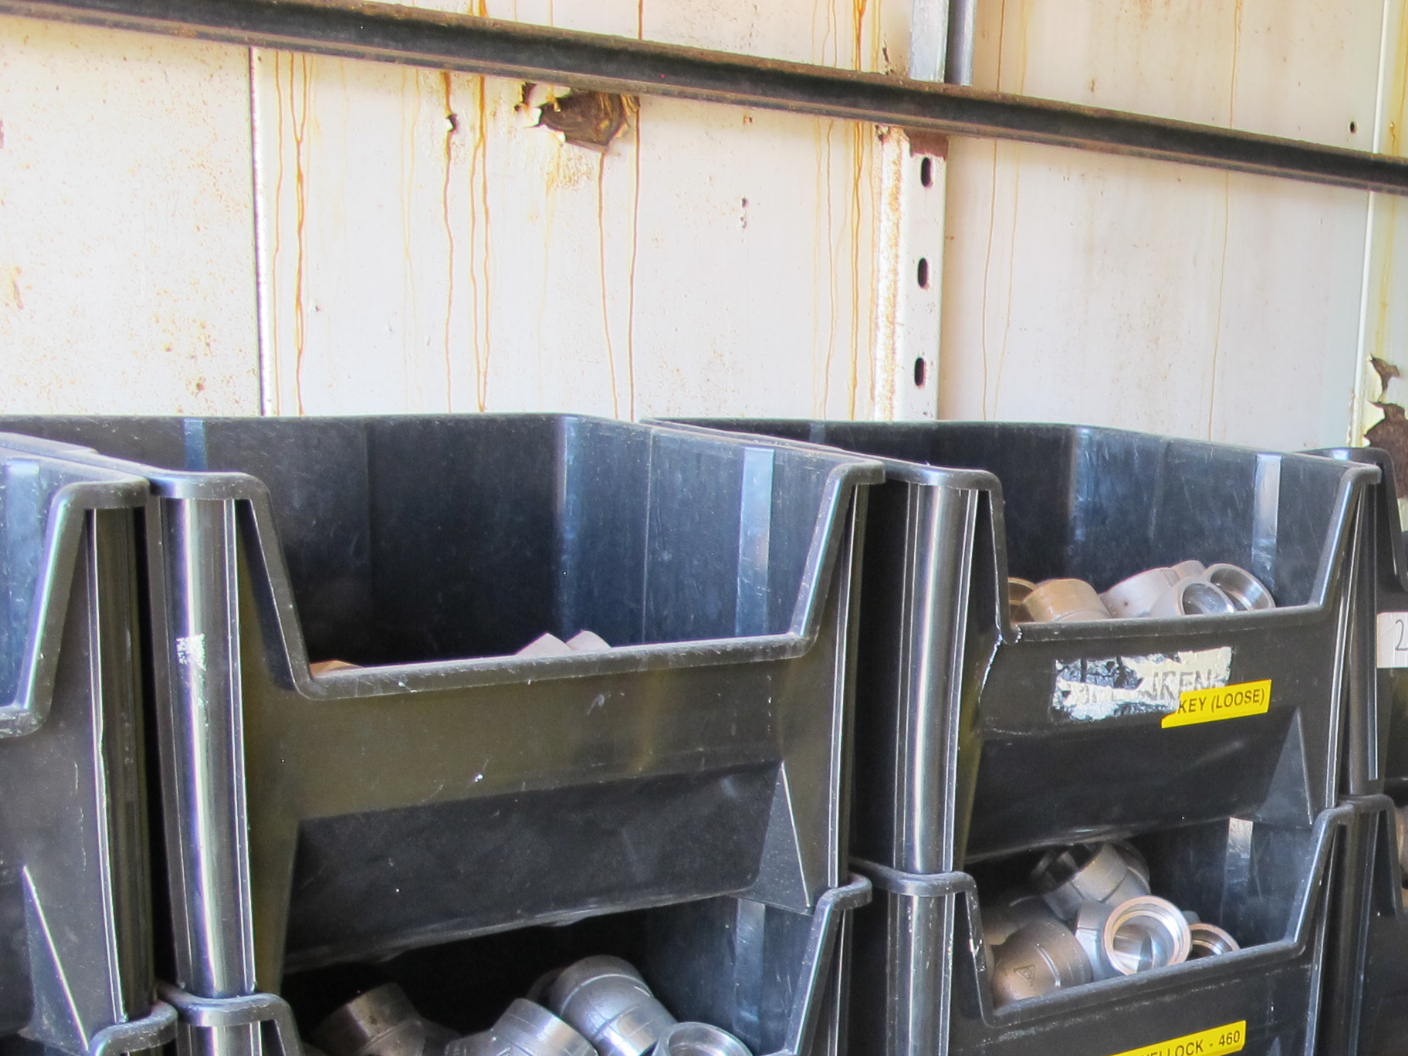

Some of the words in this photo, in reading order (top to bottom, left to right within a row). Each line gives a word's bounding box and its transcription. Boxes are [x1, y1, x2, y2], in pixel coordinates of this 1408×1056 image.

[1177, 695, 1206, 714] KEY
[1211, 687, 1266, 713] (LOOSE)
[1218, 1030, 1241, 1047] 460
